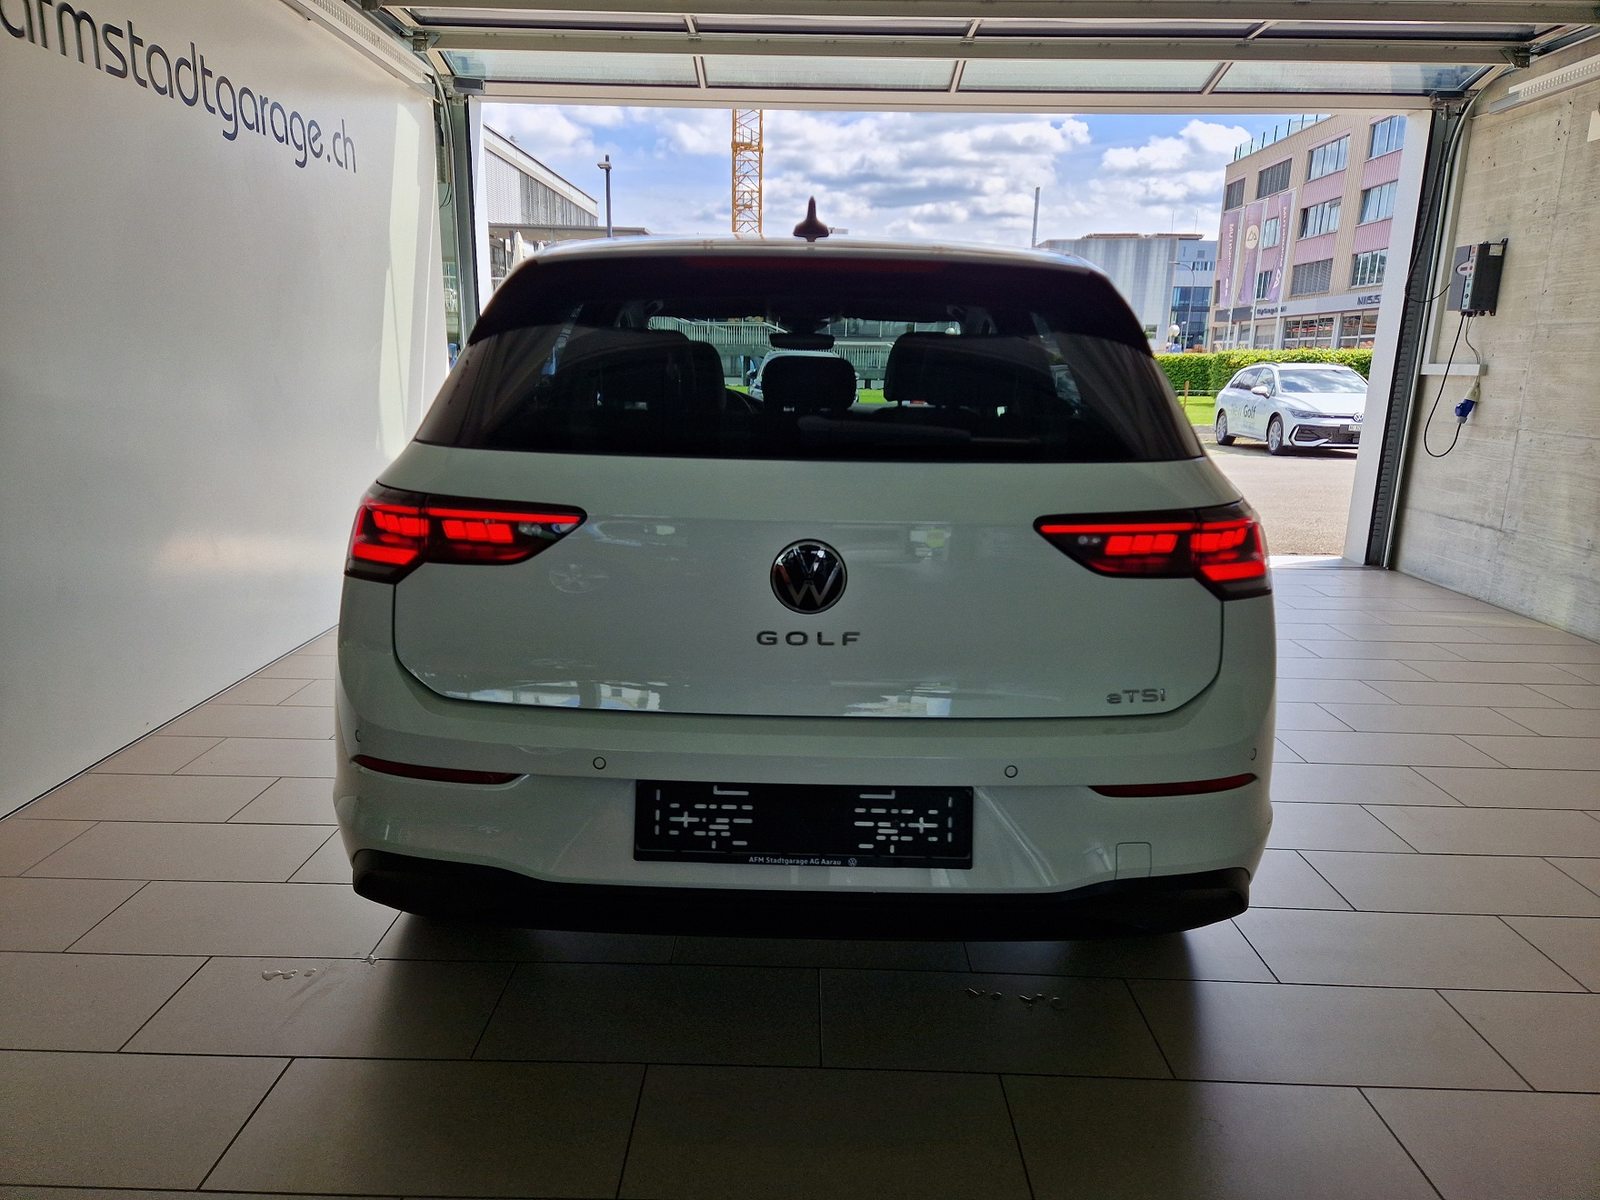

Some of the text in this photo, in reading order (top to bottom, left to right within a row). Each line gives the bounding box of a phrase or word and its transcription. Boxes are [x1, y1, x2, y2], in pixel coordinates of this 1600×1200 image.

[1243, 403, 1257, 419] Golf
[756, 630, 861, 646] GOLF
[765, 856, 808, 865] Stadtgarage
